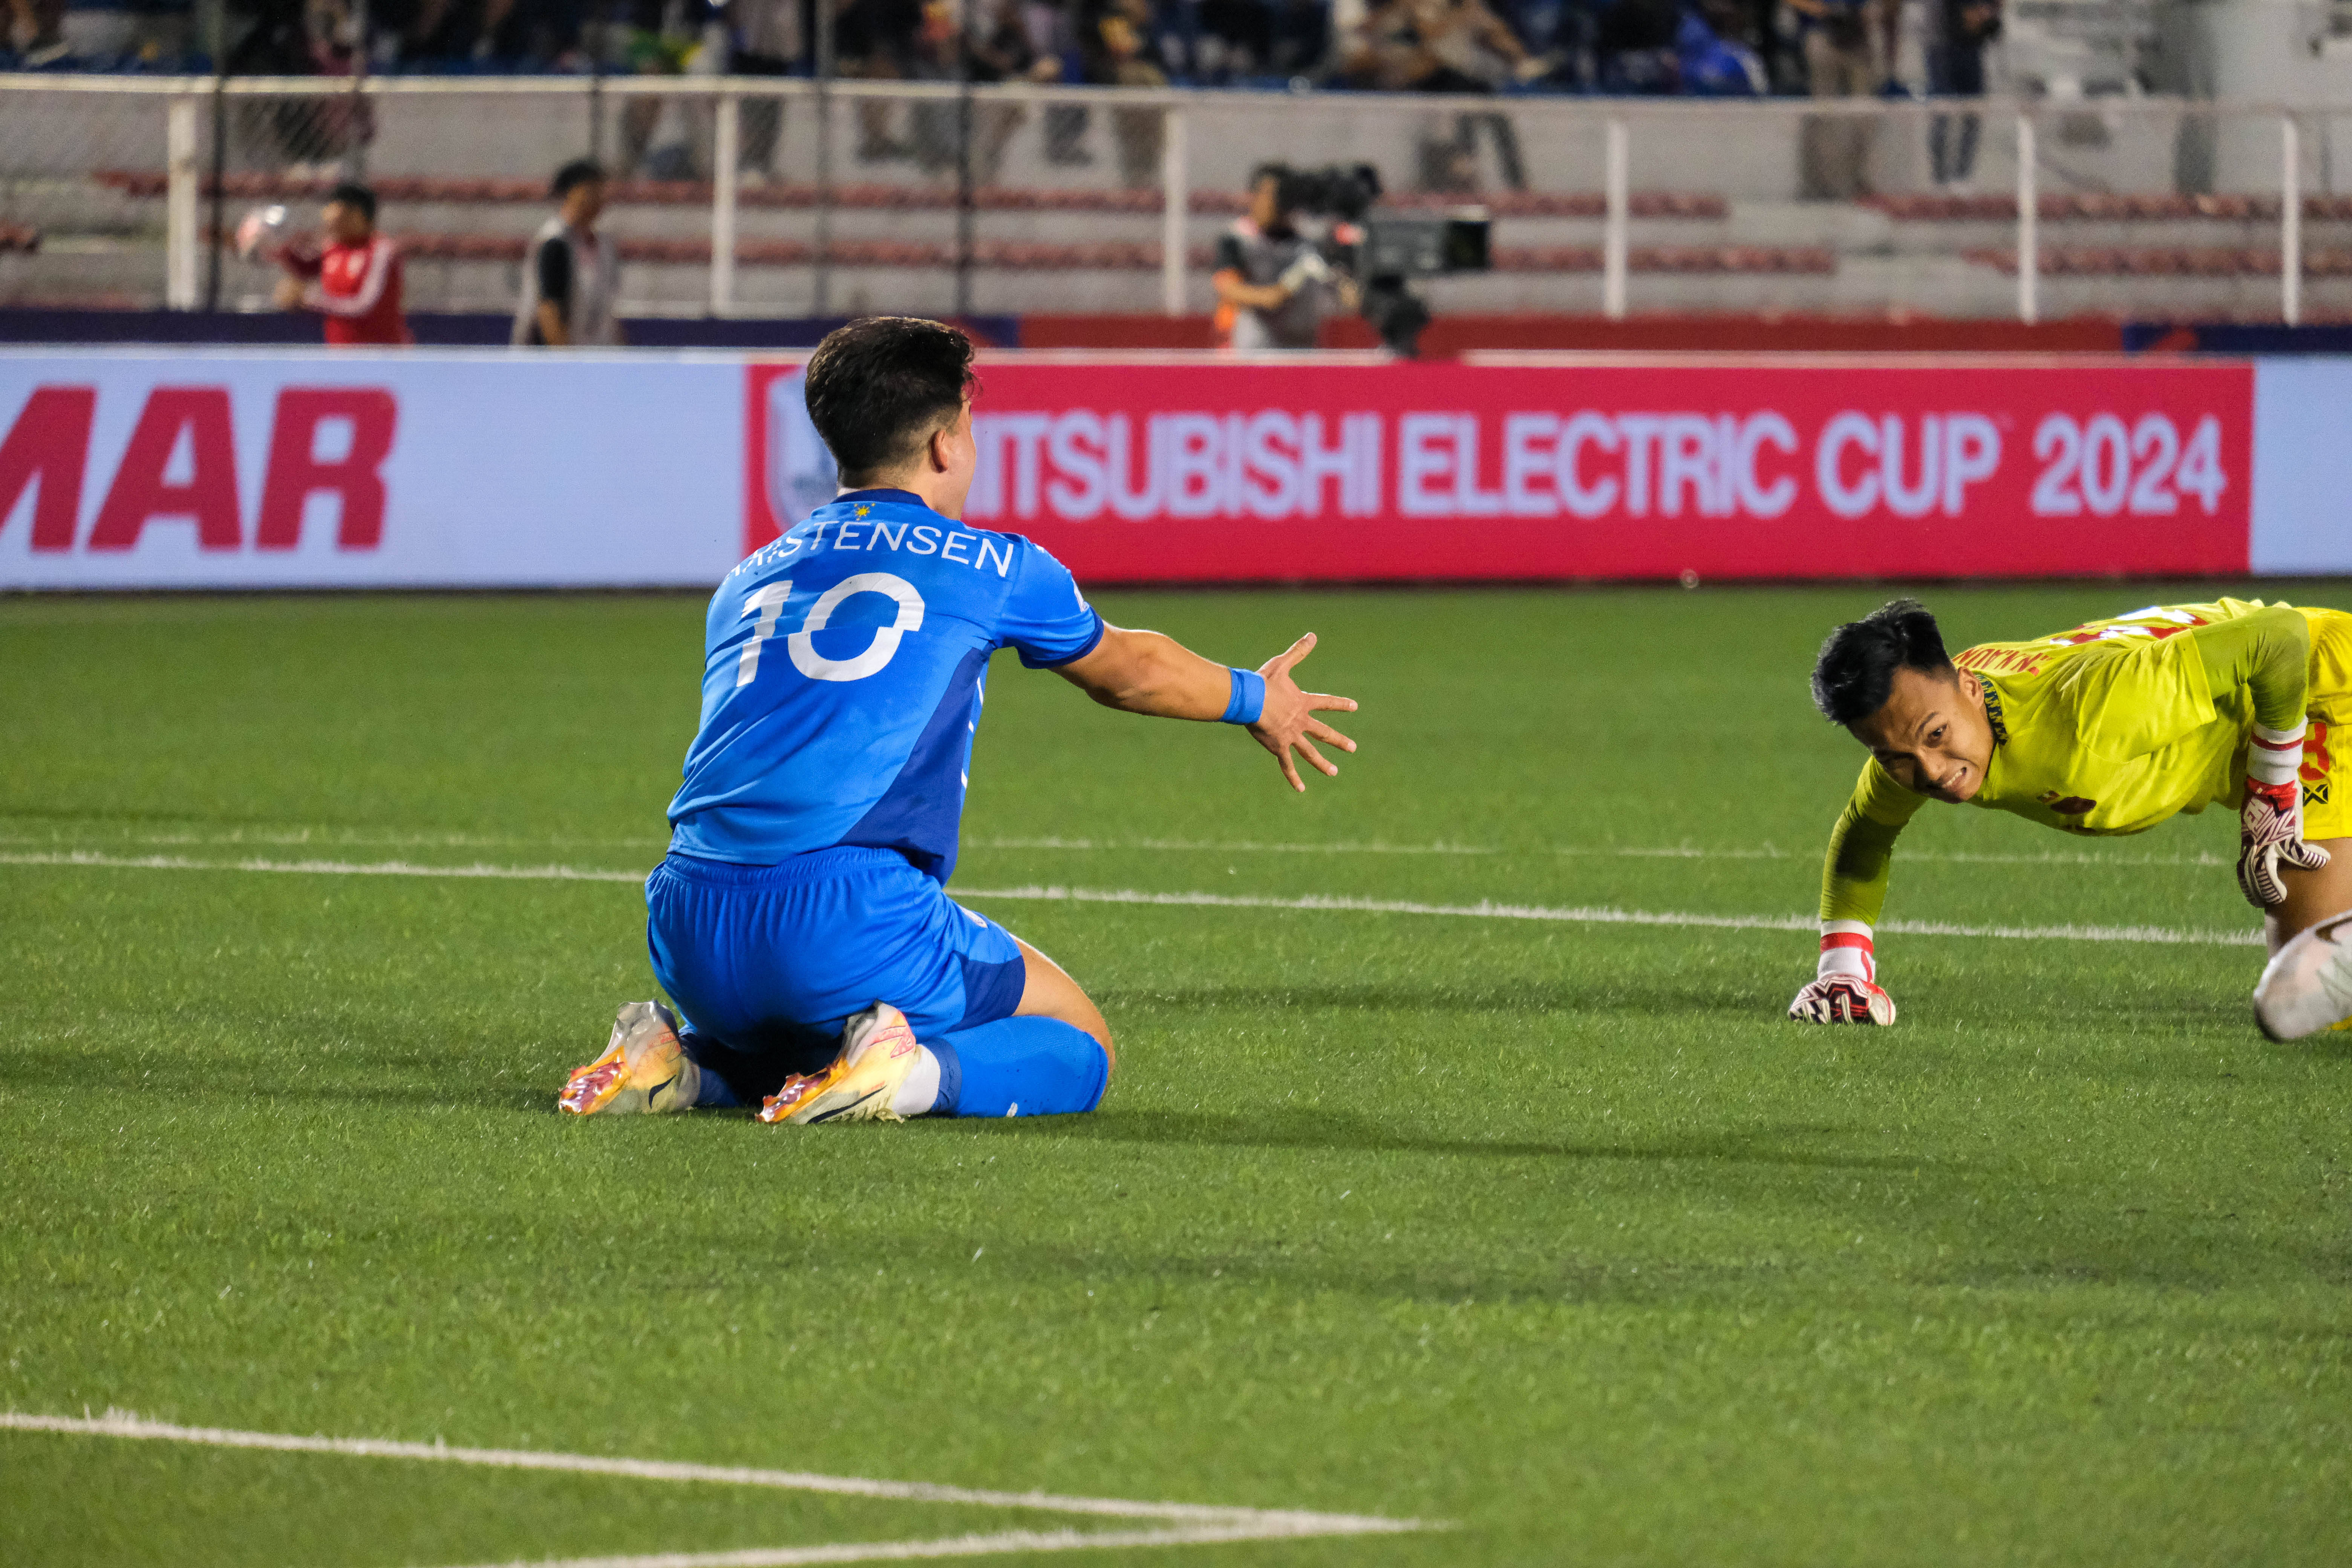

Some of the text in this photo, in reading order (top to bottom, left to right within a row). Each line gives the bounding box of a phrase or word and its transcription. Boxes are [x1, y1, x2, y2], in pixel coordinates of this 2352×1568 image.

[962, 410, 2226, 519] ITSUBISHI ELECTRIC CUP 2024
[736, 572, 926, 687] 10
